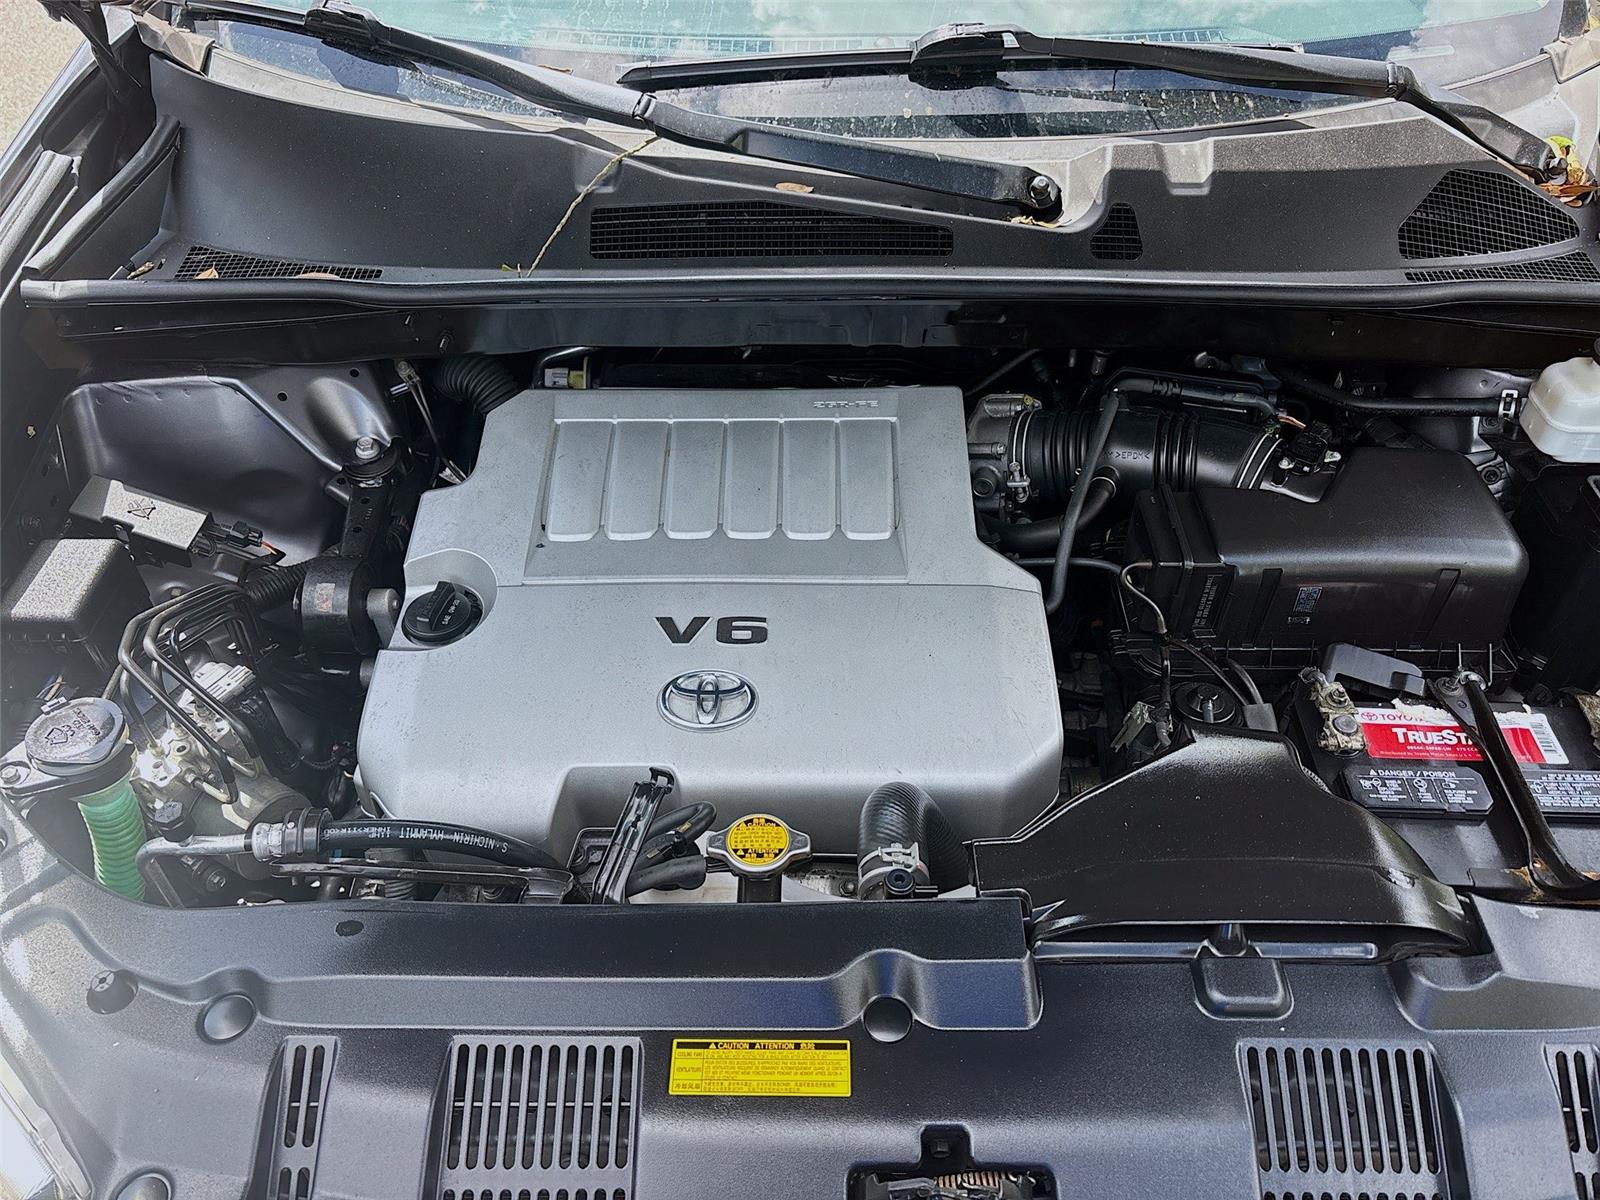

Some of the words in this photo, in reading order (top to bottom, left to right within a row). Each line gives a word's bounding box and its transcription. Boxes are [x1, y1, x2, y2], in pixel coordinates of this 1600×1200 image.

[655, 616, 769, 645] V6
[453, 831, 496, 850] NICHIRIN
[501, 841, 509, 853] S
